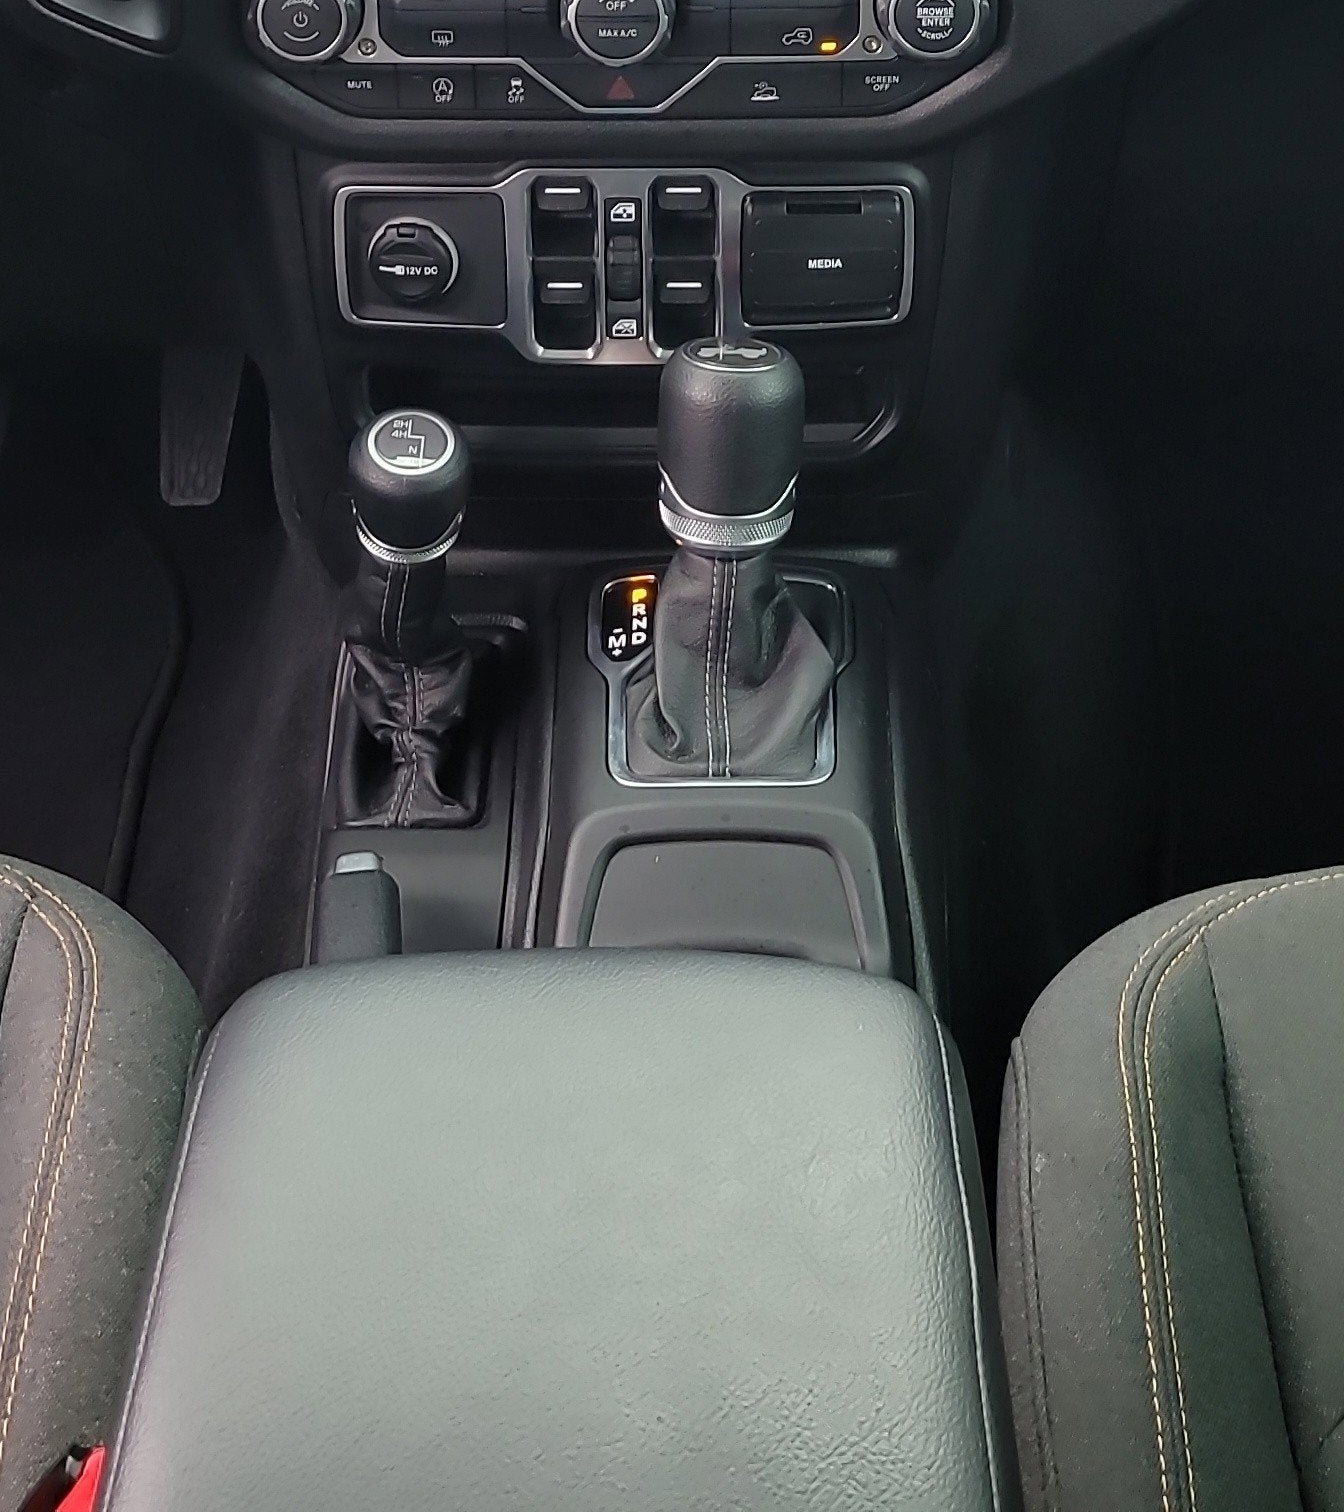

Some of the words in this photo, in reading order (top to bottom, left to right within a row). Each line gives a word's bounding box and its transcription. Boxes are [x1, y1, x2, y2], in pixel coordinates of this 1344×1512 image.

[605, 0, 627, 11] OFF
[917, 7, 954, 16] BROWSE
[921, 18, 951, 27] ENTER
[598, 29, 618, 38] MAX
[620, 29, 637, 38] A/C
[921, 30, 950, 40] SCROLL
[347, 80, 373, 90] MUTE
[864, 75, 899, 85] SCREEN
[872, 84, 891, 92] OFF
[435, 94, 452, 103] OFF
[507, 94, 525, 104] OFF
[808, 258, 842, 269] MEDIA
[406, 266, 422, 276] 12V
[391, 429, 407, 439] 4H
[408, 445, 418, 455] N
[631, 588, 647, 603] P
[632, 603, 646, 616] R
[632, 616, 648, 631] N
[608, 633, 627, 649] M
[631, 631, 647, 645] D
